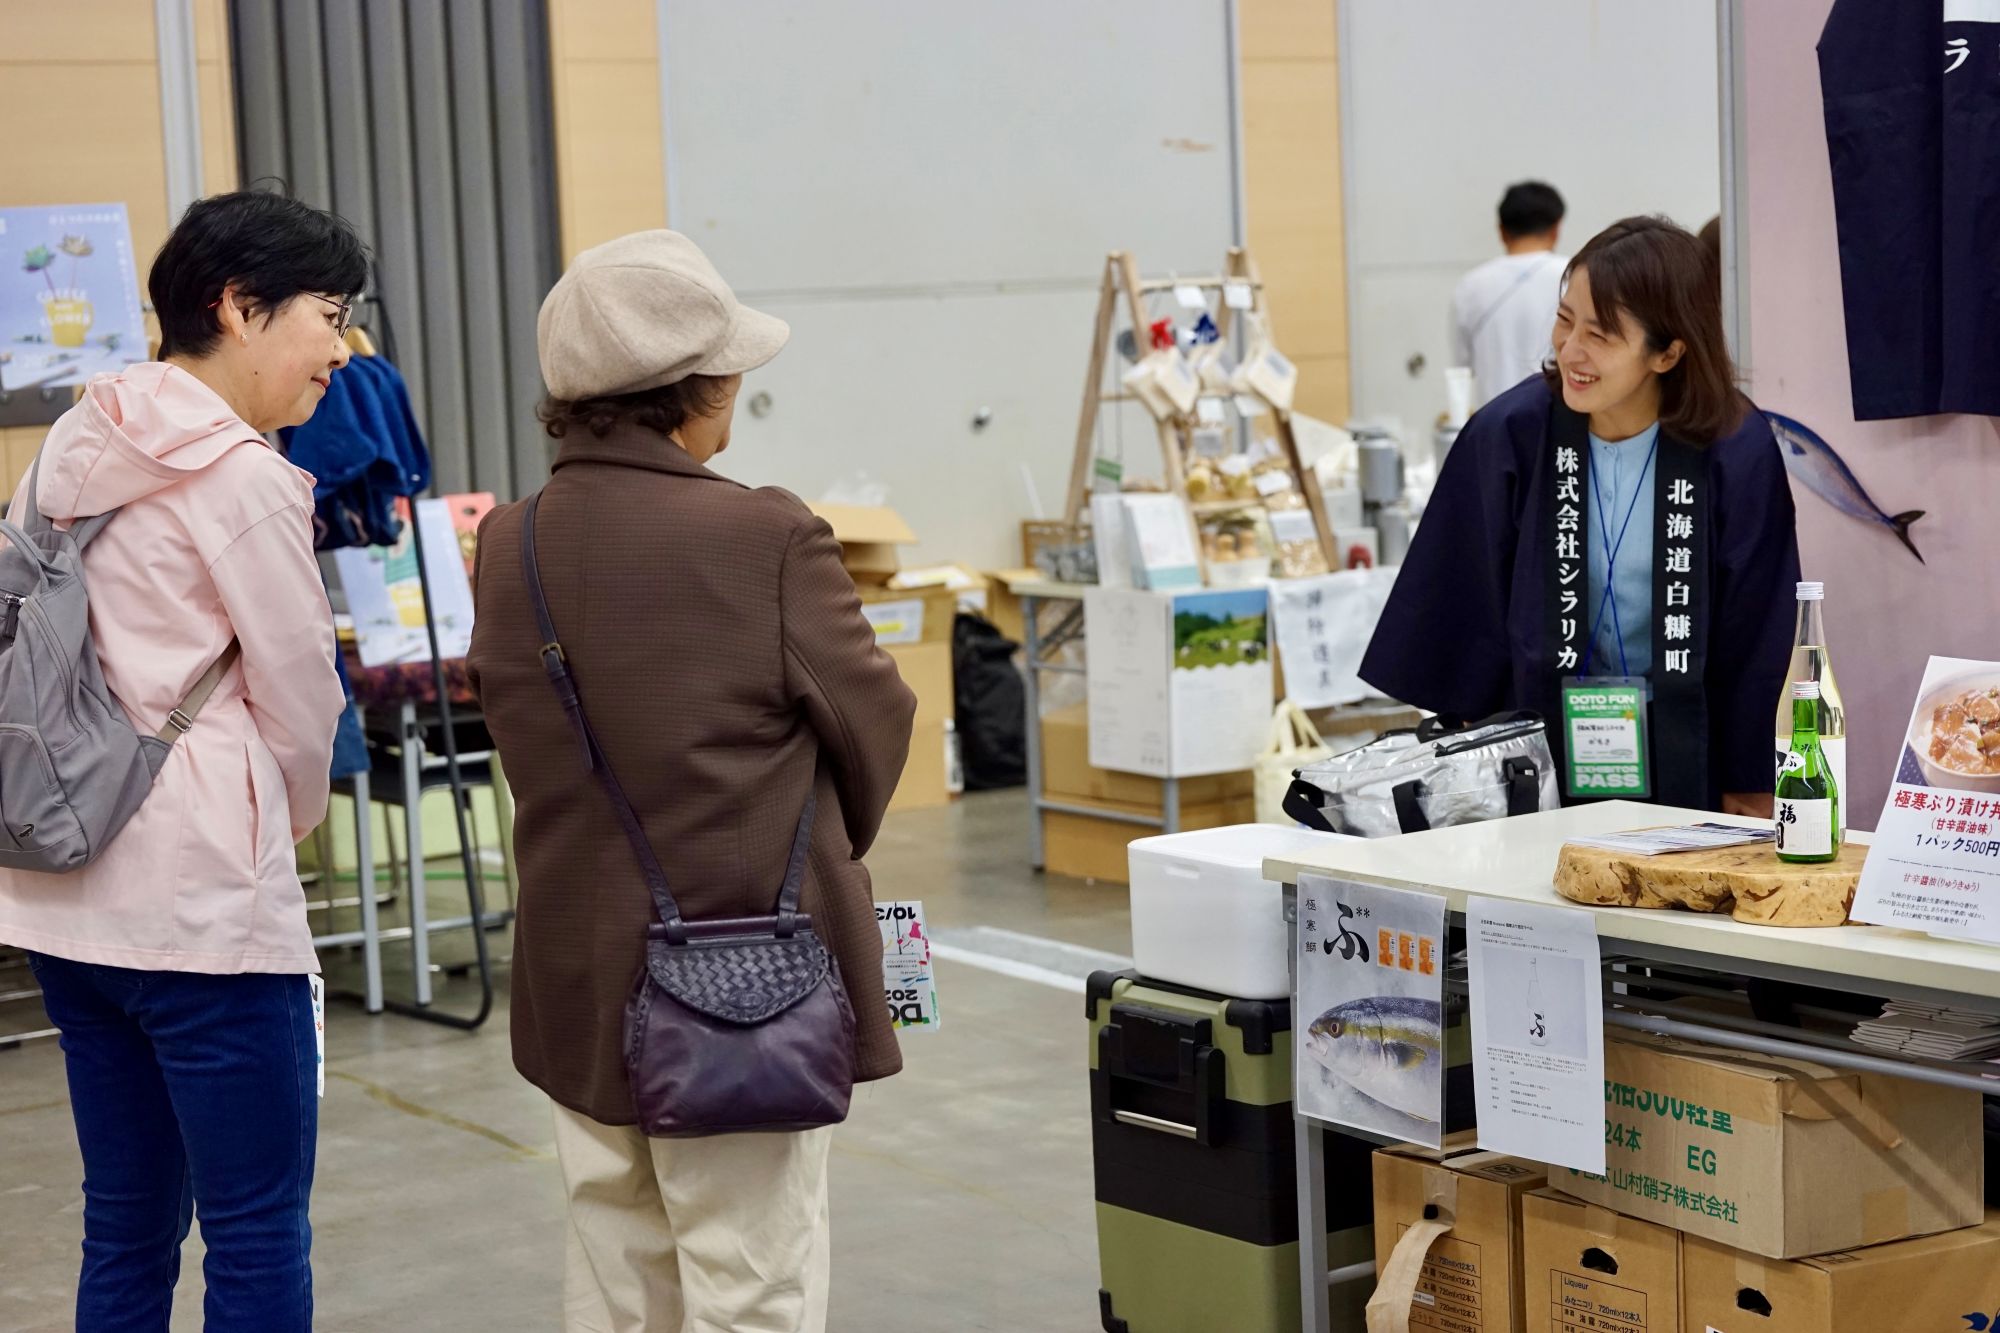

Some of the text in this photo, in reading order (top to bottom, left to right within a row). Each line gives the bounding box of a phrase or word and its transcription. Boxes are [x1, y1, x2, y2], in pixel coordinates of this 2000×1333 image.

[1554, 446, 1580, 671] 株式会社シラリカ
[1664, 478, 1694, 674] 北海道白糠町
[1569, 695, 1635, 704] DOTO FUN
[1576, 773, 1640, 788] PASS
[1687, 1144, 1717, 1177] EG
[1564, 1278, 1590, 1291] Liqueur
